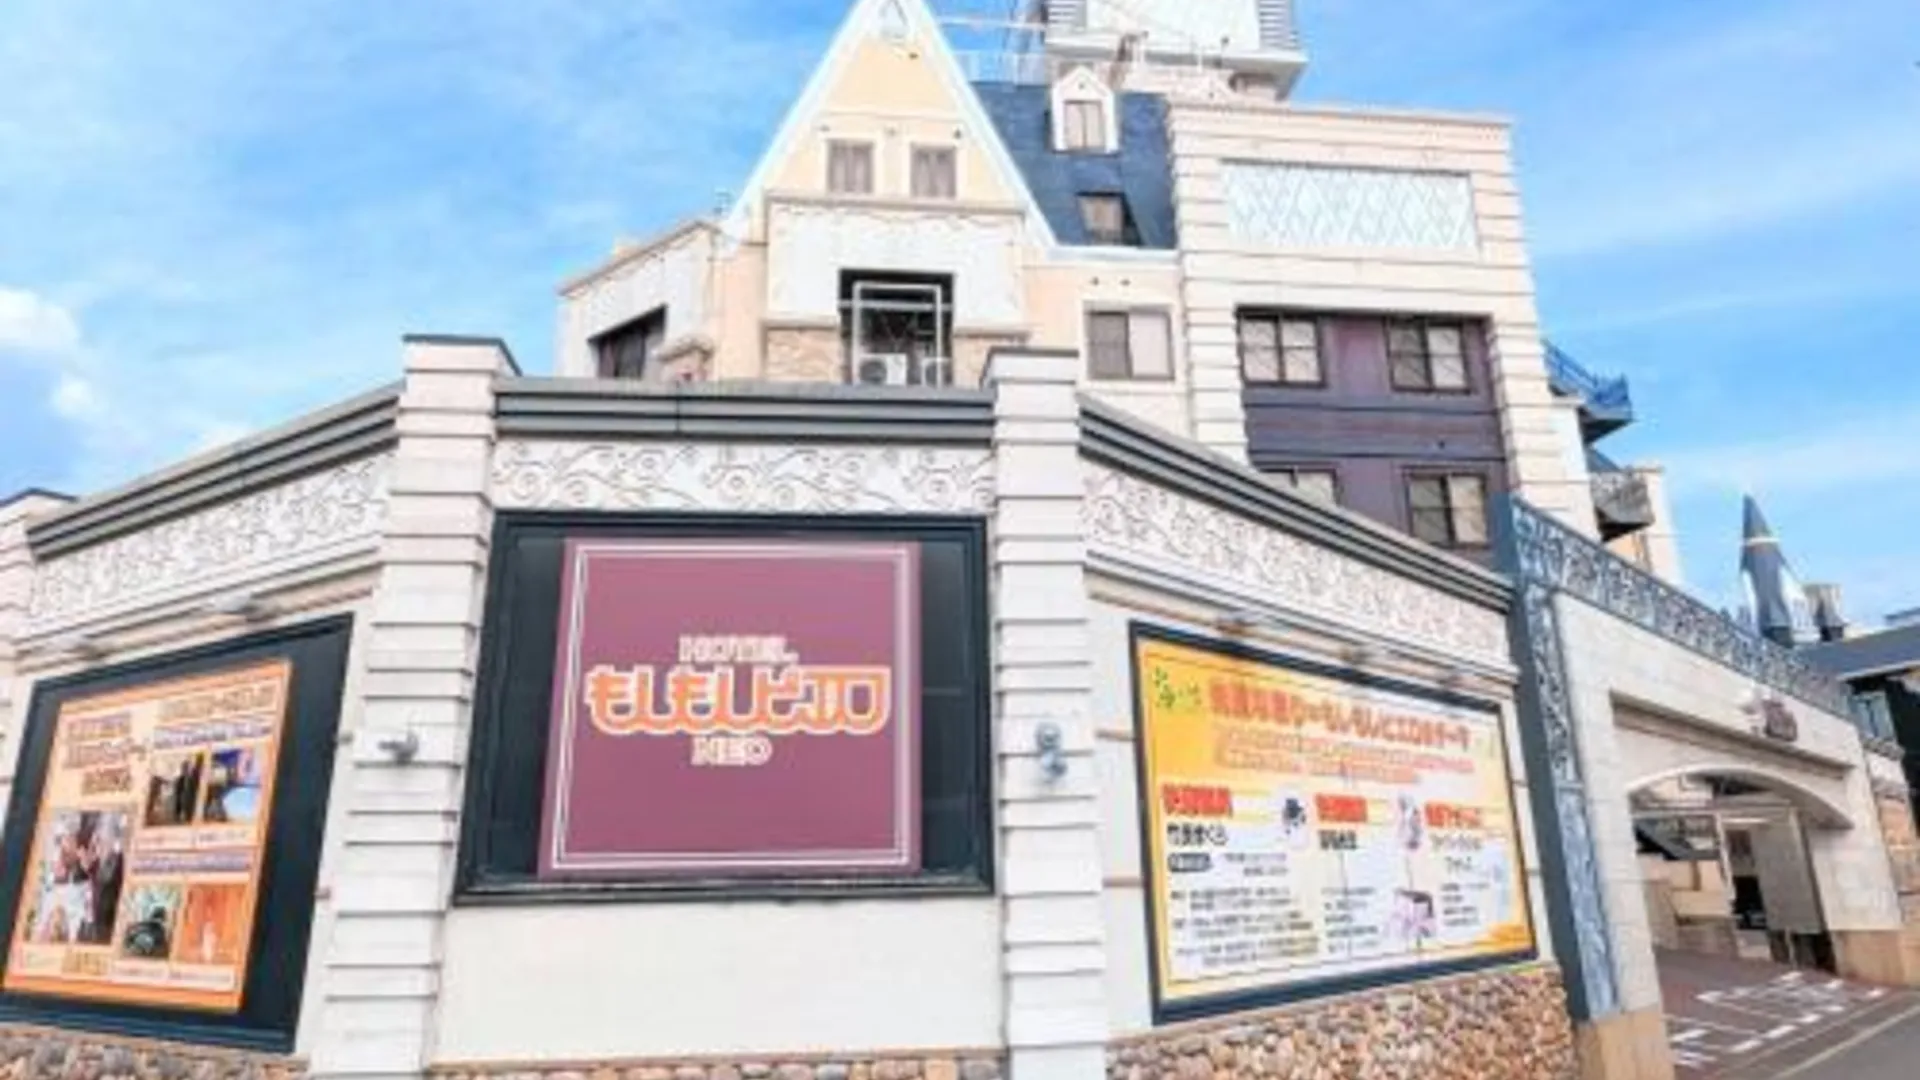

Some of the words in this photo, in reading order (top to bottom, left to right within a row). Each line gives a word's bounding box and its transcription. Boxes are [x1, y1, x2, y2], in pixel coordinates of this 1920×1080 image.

[679, 635, 799, 662] HOTEL
[584, 664, 892, 735] もしもしピエロ
[690, 736, 773, 766] NEO
